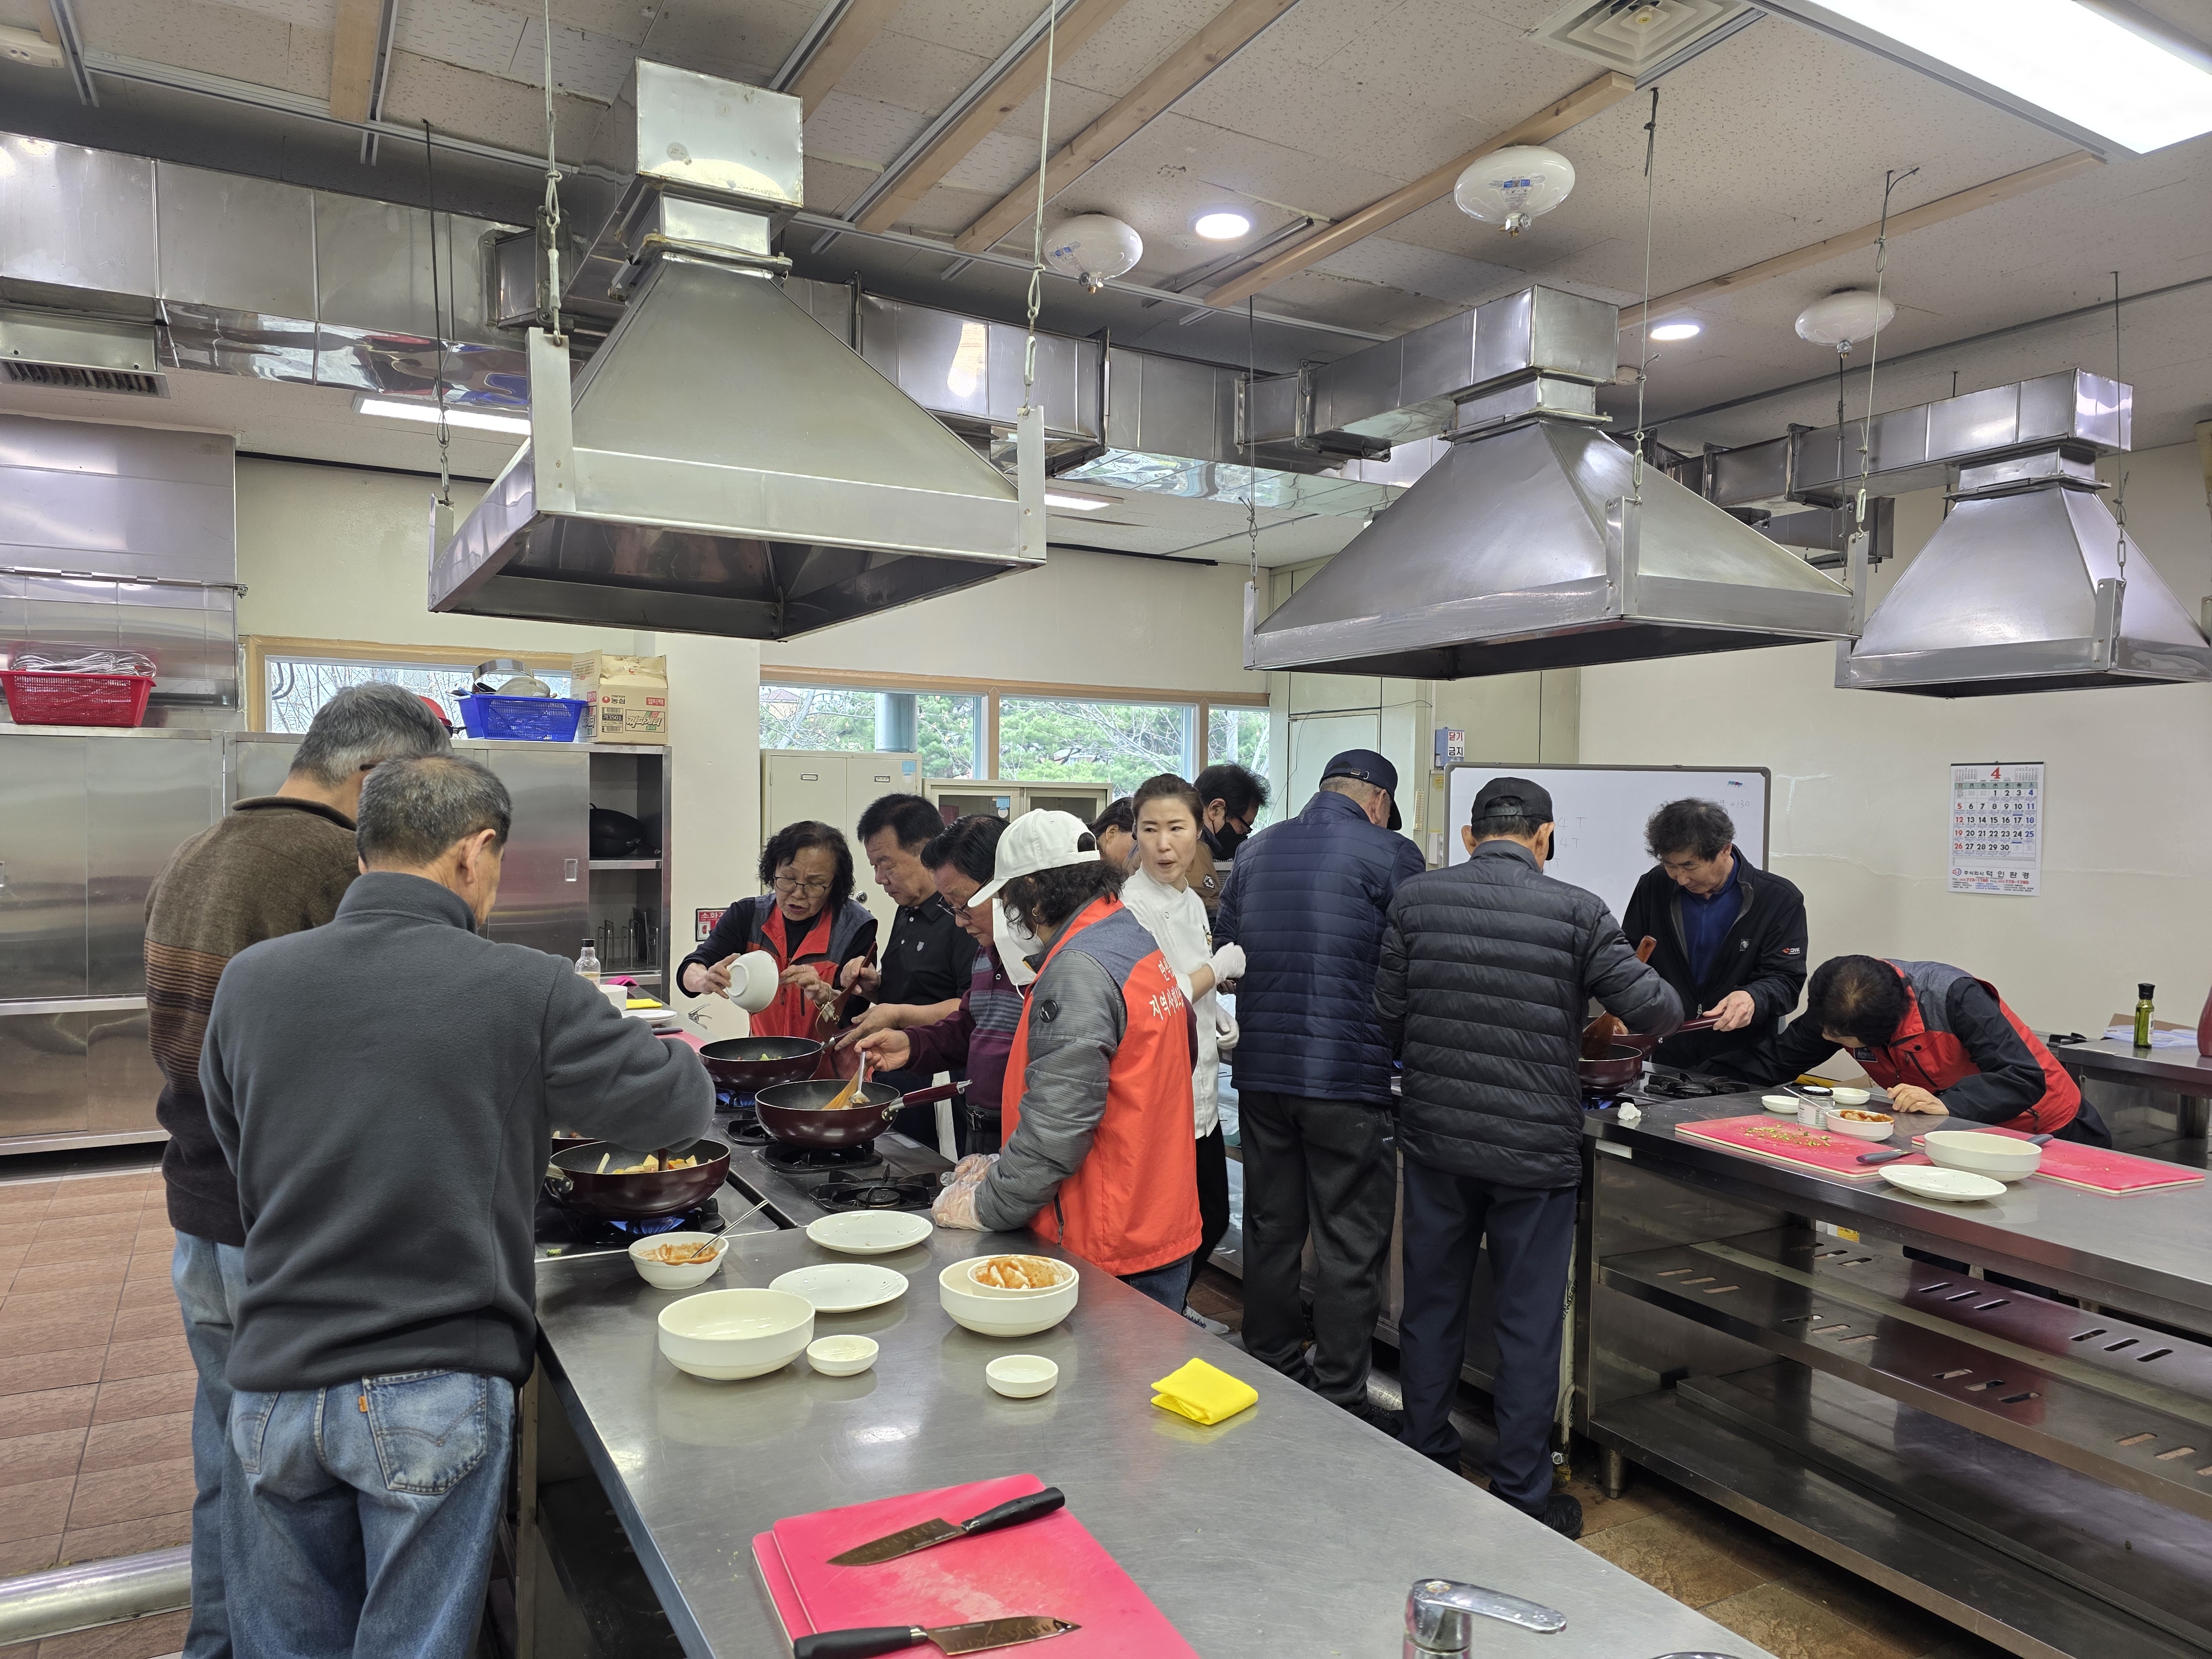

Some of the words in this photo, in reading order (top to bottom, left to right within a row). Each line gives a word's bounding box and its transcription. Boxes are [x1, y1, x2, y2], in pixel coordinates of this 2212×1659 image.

[1449, 732, 1463, 742] 닫기
[1449, 747, 1463, 757] 금지
[1990, 767, 2001, 779] 4
